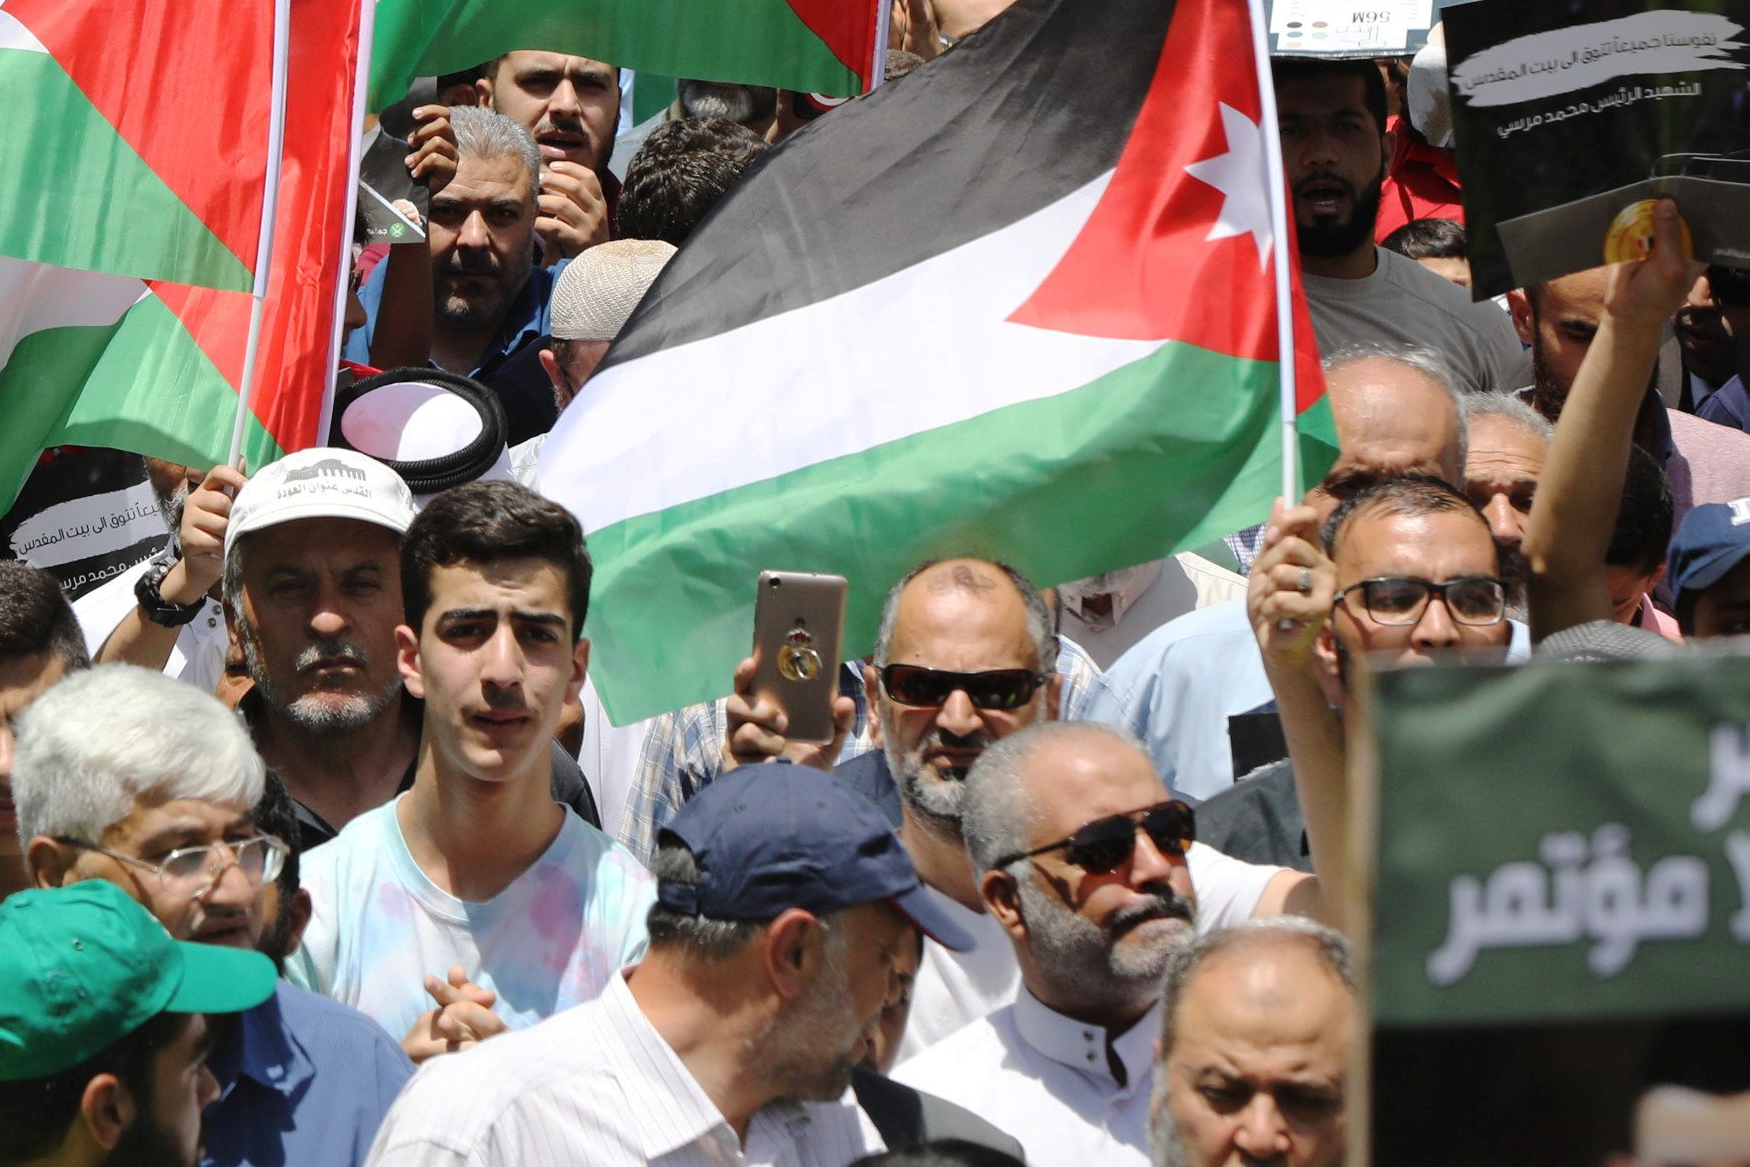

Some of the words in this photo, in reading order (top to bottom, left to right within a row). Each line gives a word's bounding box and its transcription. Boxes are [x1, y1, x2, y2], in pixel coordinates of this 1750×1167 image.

[1352, 11, 1391, 24] 56M
[1544, 102, 1590, 123] محمد
[1496, 114, 1543, 139] مرسي
[308, 480, 339, 494] عنوان
[342, 484, 372, 498] القدس
[92, 516, 108, 534] الى
[109, 507, 136, 530] تتوق
[18, 528, 65, 556] المقدس
[66, 524, 90, 540] بيت
[59, 572, 87, 591] مرس
[88, 562, 127, 583] محمد
[1426, 822, 1709, 985] مؤتمر
